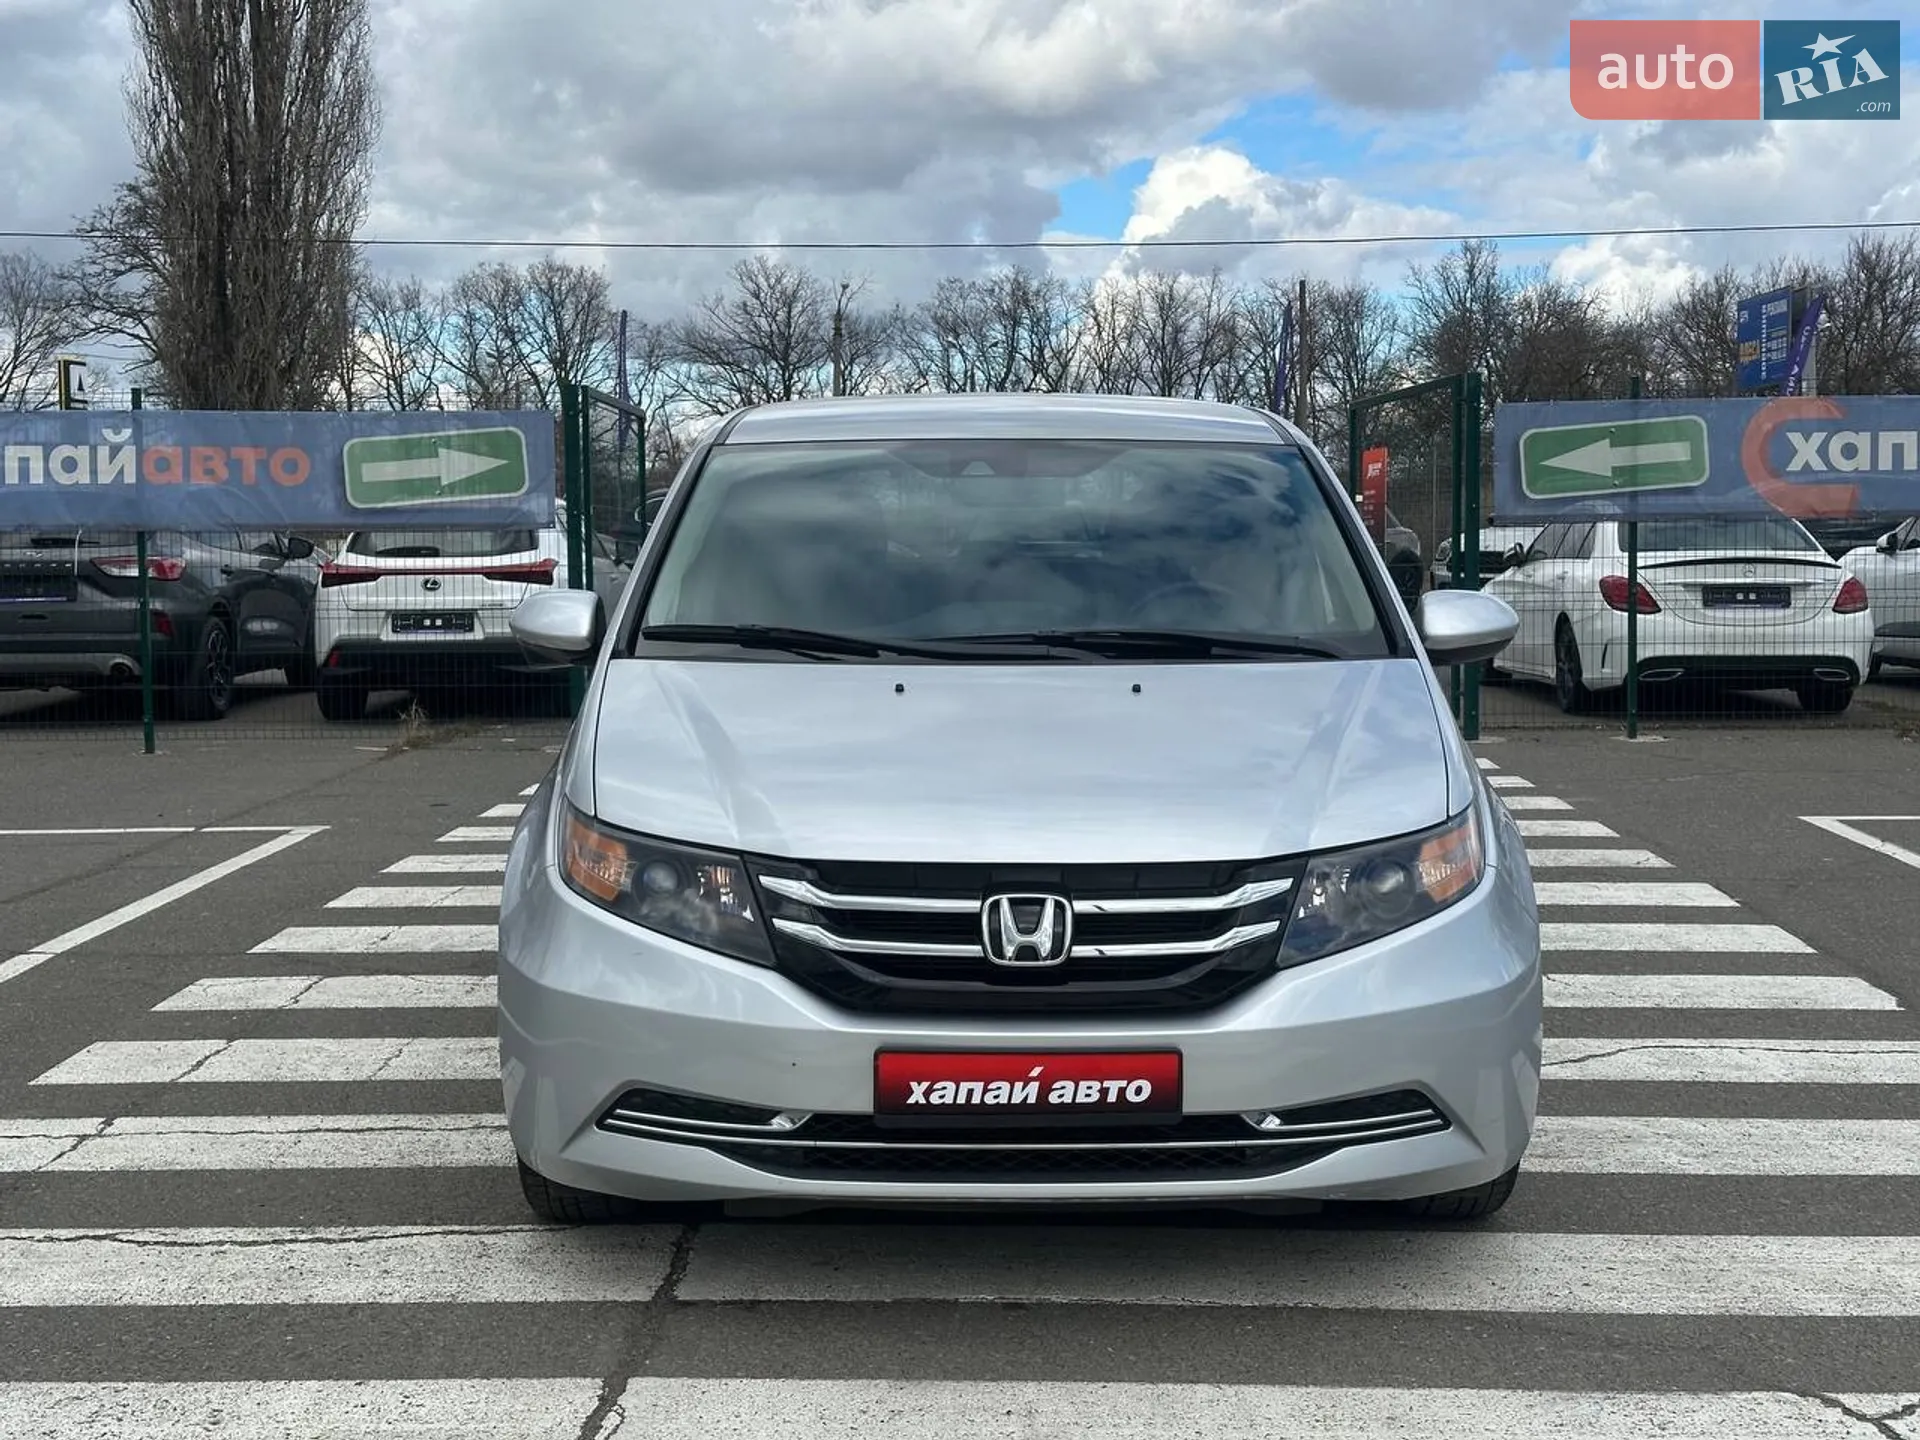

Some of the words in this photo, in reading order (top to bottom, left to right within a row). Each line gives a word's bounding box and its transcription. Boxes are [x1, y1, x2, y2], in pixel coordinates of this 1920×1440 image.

[1785, 430, 1918, 472] хап
[906, 1066, 1044, 1105] хапай
[1048, 1078, 1152, 1104] авто
